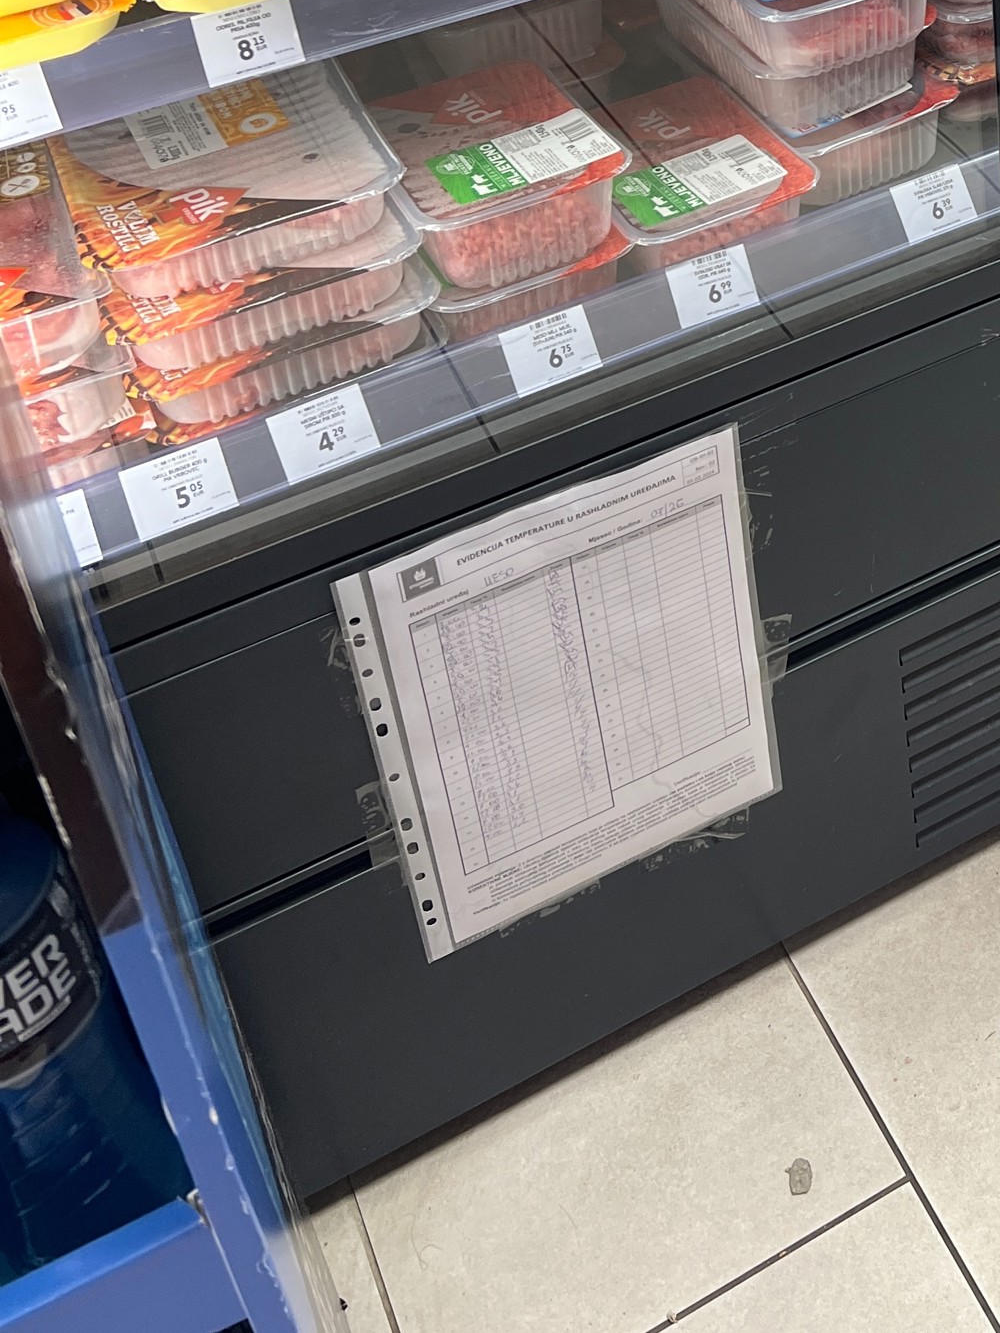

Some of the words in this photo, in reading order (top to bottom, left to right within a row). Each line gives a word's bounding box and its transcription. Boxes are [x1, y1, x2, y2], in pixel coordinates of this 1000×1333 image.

[237, 38, 254, 62] 8
[253, 35, 266, 47] 15
[256, 42, 269, 51] EUR
[1, 104, 17, 116] 95
[445, 93, 503, 124] pik
[638, 109, 691, 140] pik
[479, 143, 526, 187] MLJEVENO
[651, 165, 704, 208] MLJEVENO
[169, 187, 230, 222] pik
[932, 201, 944, 220] 6
[941, 197, 951, 208] 39
[96, 203, 141, 253] ROŠTILJ
[117, 200, 160, 246] VOLIM
[708, 283, 722, 304] 6
[720, 280, 732, 291] 99
[723, 287, 733, 295] EUR
[532, 332, 548, 341] MESO
[549, 348, 563, 368] 6
[560, 343, 572, 355] 75
[564, 351, 575, 359] EUR
[300, 416, 316, 426] MESNI
[316, 408, 337, 422] UŠTIPCI
[303, 420, 322, 430] SIROM
[318, 432, 334, 452] 4
[332, 425, 345, 438] 29
[336, 434, 348, 442] EUR
[152, 471, 168, 481] GRILL
[168, 464, 191, 477] BURGER
[191, 460, 202, 469] 400
[173, 467, 200, 479] VRBOVEC
[175, 485, 190, 509] 5
[189, 480, 203, 492] 05
[192, 489, 205, 498] EUR
[456, 541, 504, 566] EVIDENCIJA
[505, 518, 566, 545] TEMPERATURE
[575, 494, 629, 519] RASHLADNIM
[630, 474, 676, 498] UREĐAJIMA
[588, 531, 612, 544] Mjesec
[409, 598, 446, 618] Rashladni
[446, 588, 469, 603] uređaj
